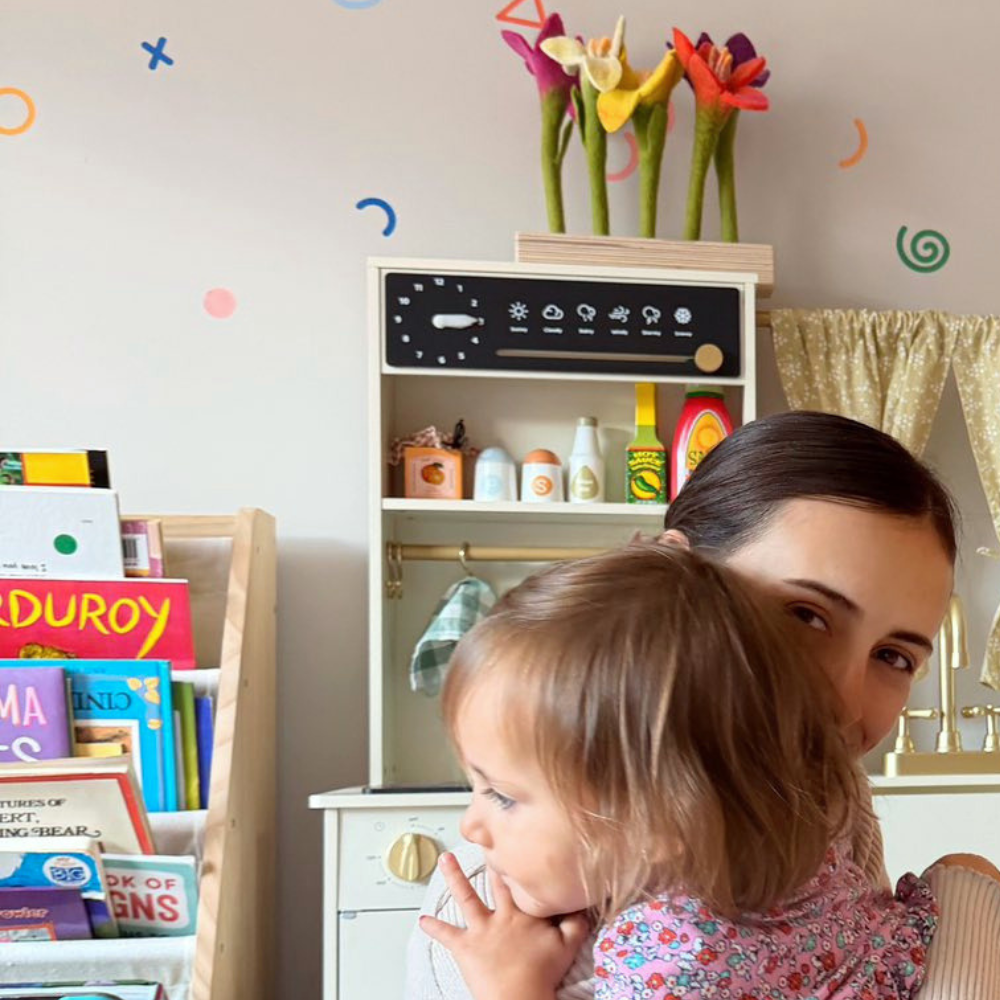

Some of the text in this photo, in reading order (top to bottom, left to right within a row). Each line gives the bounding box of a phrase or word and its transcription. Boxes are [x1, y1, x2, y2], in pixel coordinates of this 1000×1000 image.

[434, 277, 445, 287] 12
[413, 283, 424, 292] 11
[457, 284, 464, 293] 1
[399, 296, 411, 306] 10
[471, 299, 478, 308] 2
[31, 825, 102, 838] BEAR
[146, 877, 177, 890] OF
